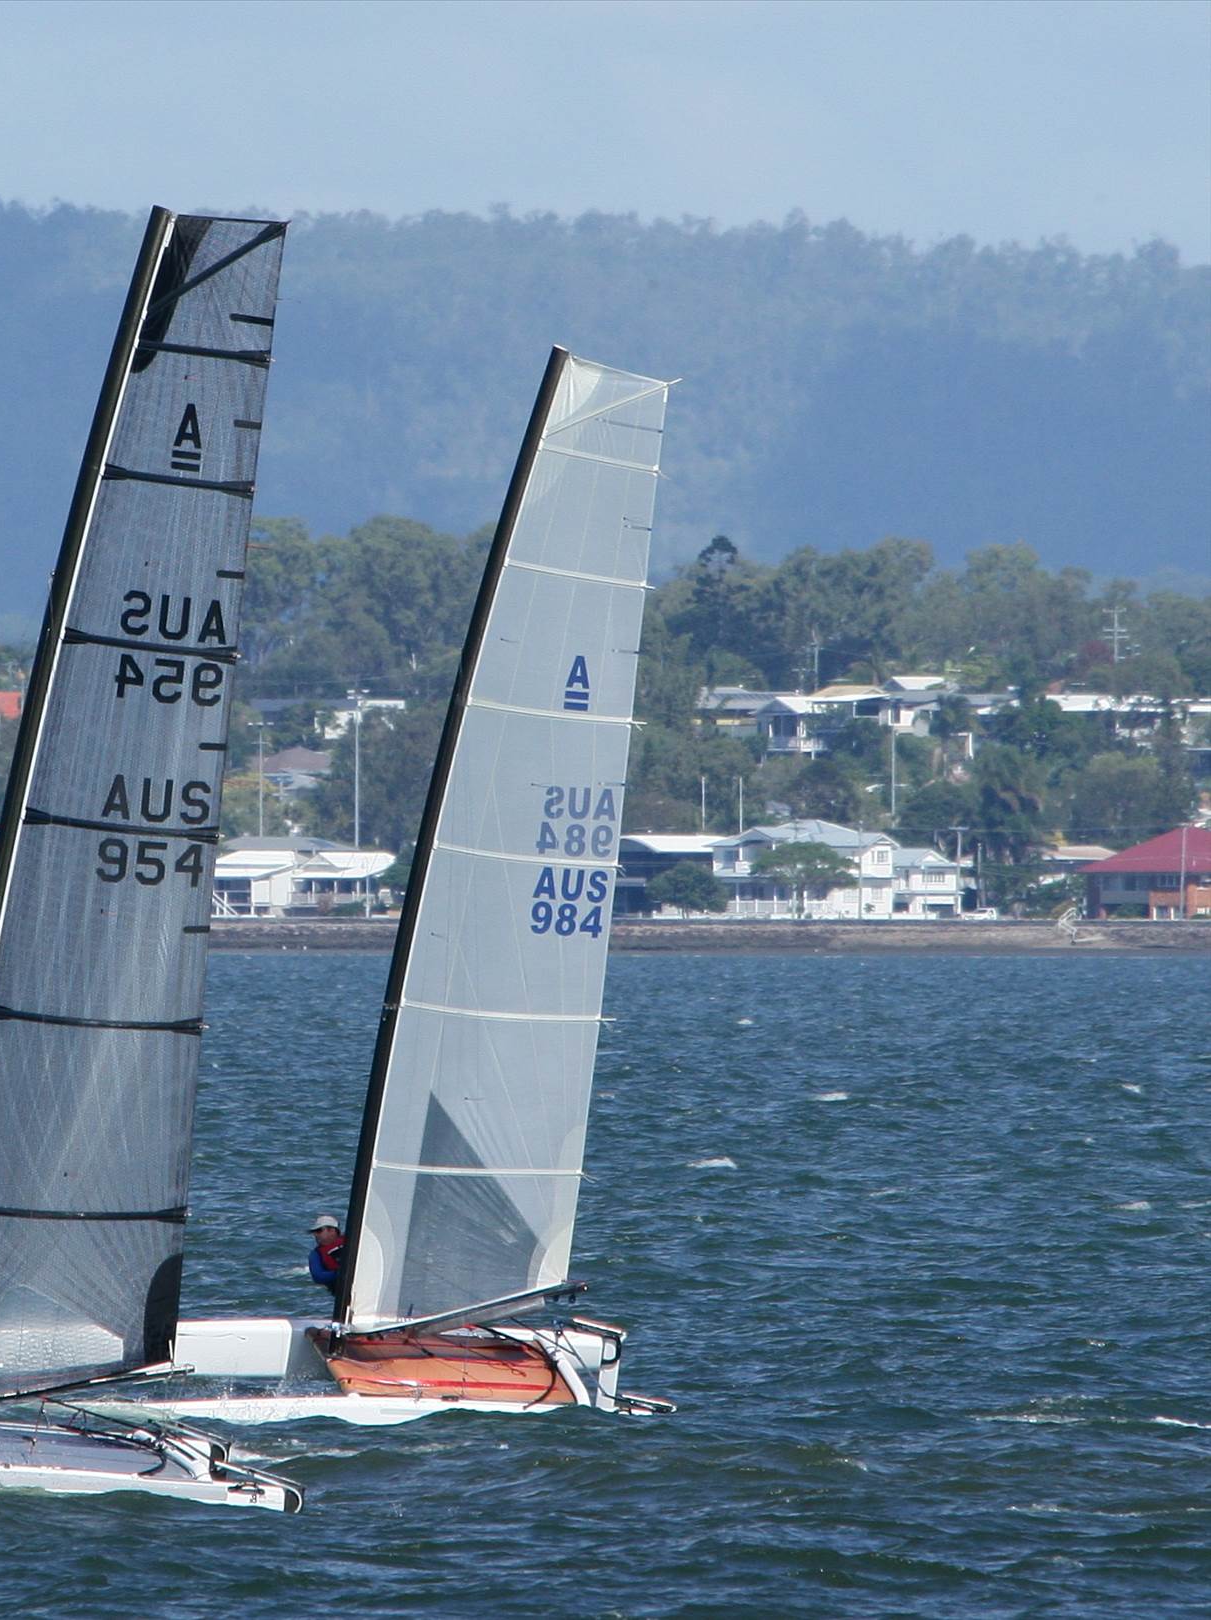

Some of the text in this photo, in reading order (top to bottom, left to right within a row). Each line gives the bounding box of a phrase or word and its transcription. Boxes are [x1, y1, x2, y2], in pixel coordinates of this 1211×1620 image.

[173, 404, 201, 449] A
[566, 655, 590, 689] A
[102, 774, 211, 825] AUS
[96, 838, 204, 888] 954
[532, 867, 608, 903] AUS
[530, 901, 603, 938] 984
